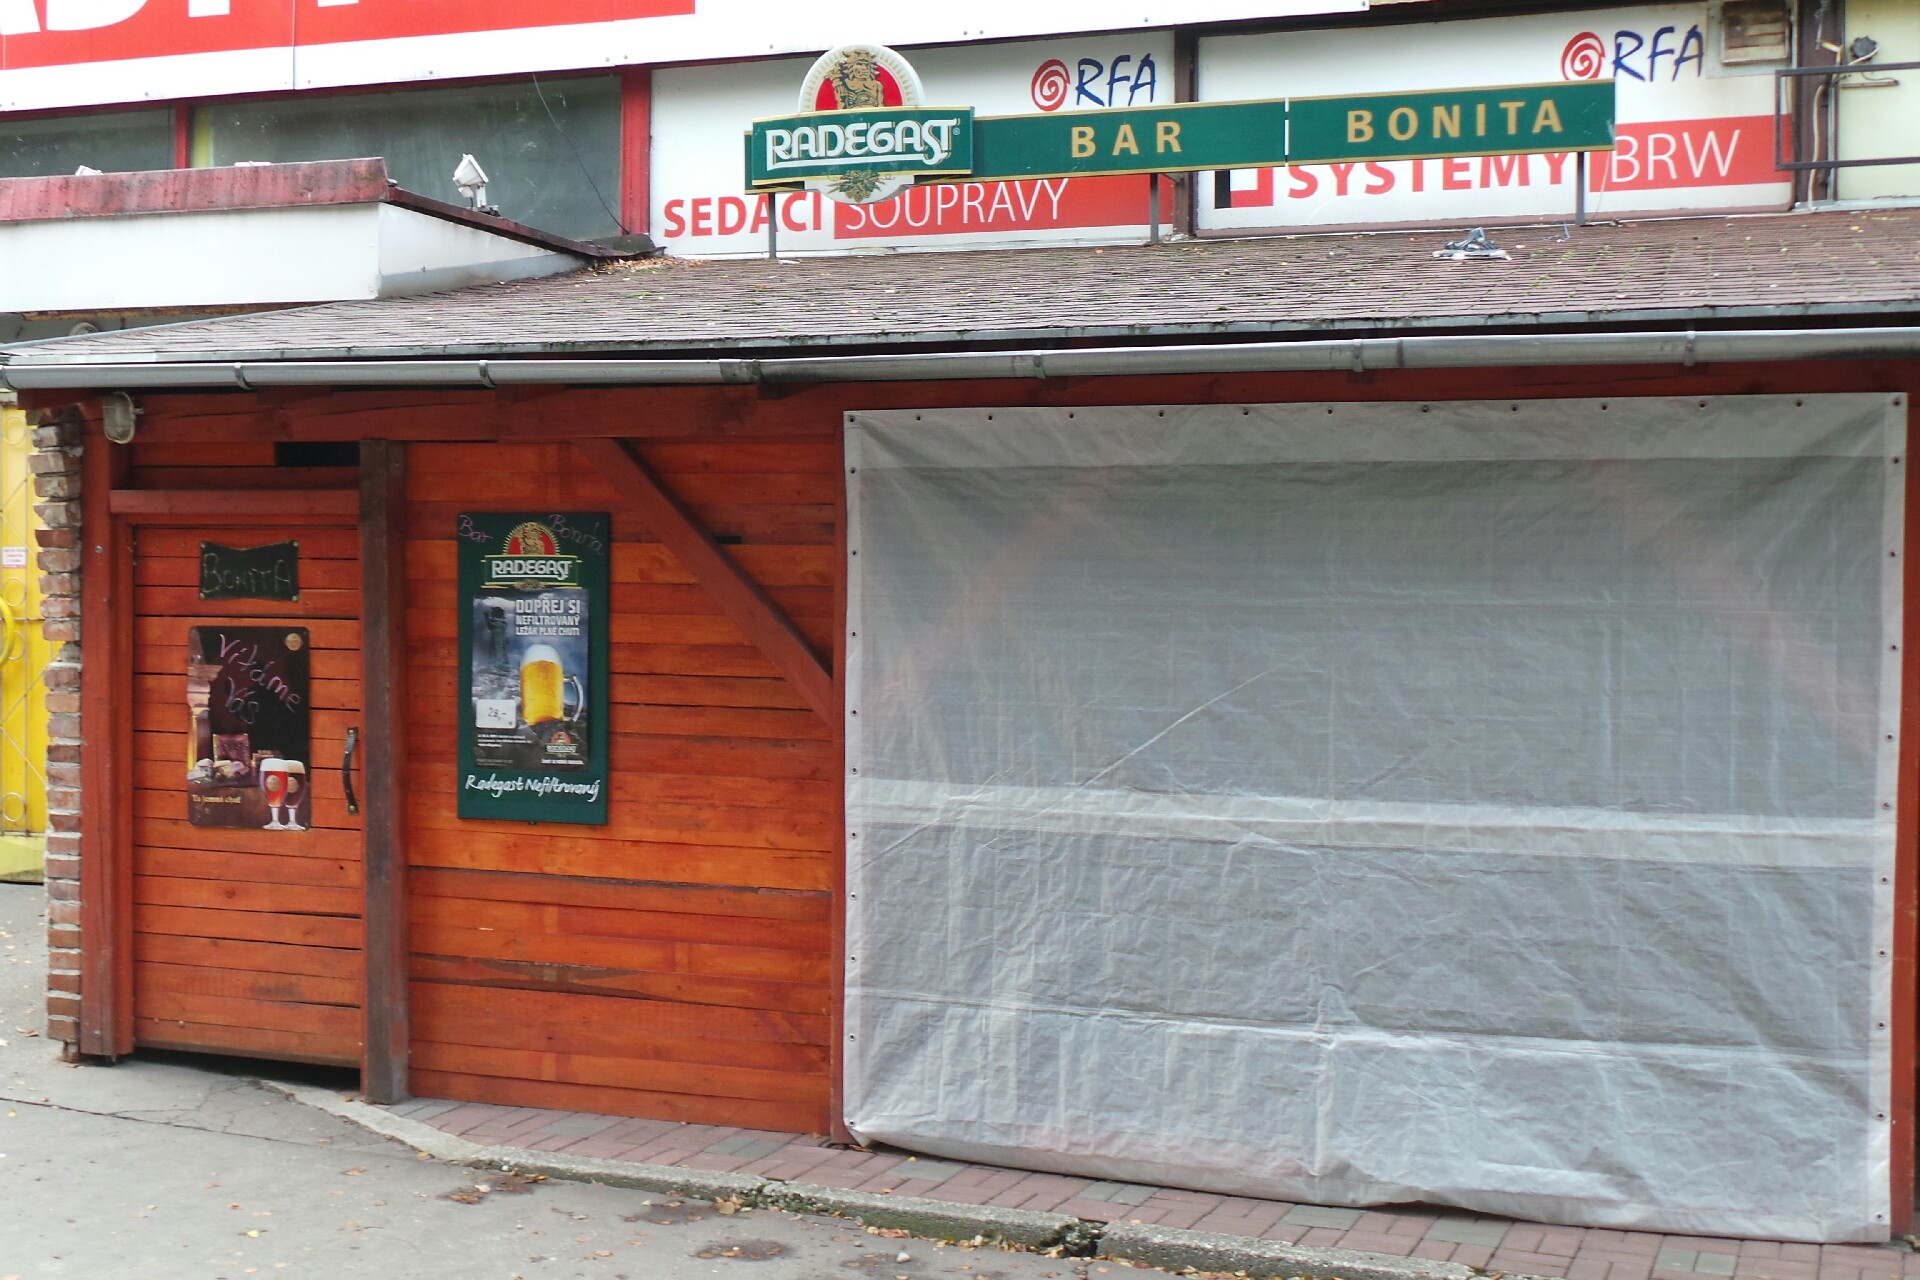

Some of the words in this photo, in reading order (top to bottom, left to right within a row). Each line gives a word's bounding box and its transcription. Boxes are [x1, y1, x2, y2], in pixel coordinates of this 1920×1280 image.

[1071, 120, 1183, 158] BAR
[1346, 98, 1564, 144] BONITA
[1611, 129, 1740, 183] BRW
[845, 178, 1069, 231] SOUPRAVY
[491, 560, 573, 581] RADEGAST
[515, 597, 565, 614] DOPŘEJ
[568, 599, 581, 614] SI
[465, 773, 524, 798] Radegast
